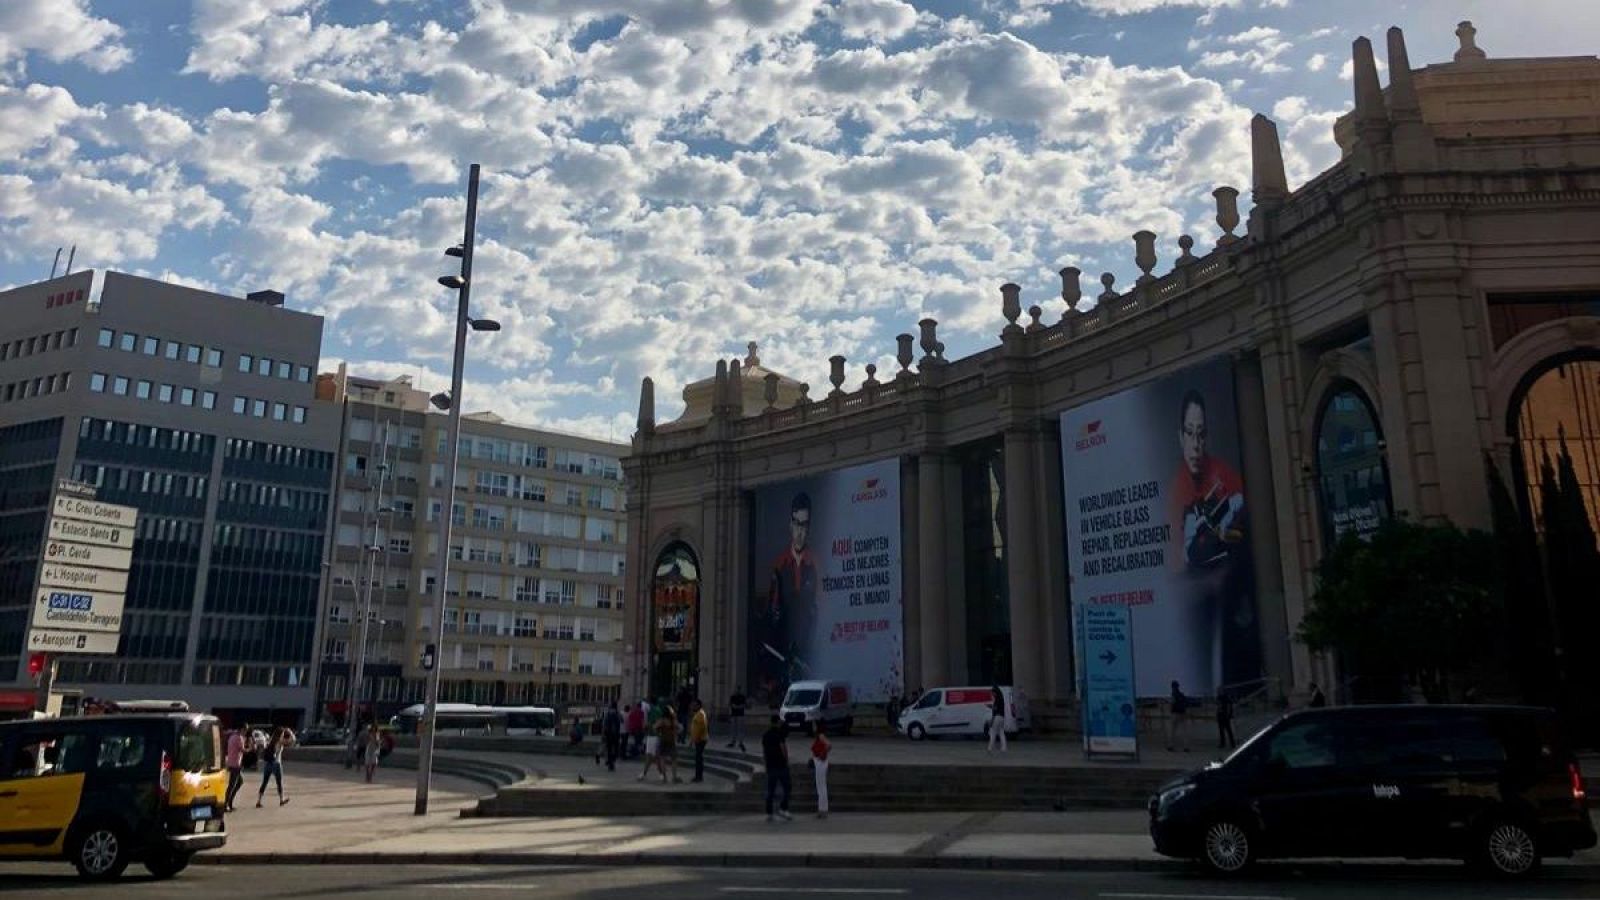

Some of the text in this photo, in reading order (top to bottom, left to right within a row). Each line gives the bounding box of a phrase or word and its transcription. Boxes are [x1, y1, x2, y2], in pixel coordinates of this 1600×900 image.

[1076, 435, 1106, 450] BELRON
[1079, 481, 1159, 512] WORLDWIDE LEADER
[76, 502, 92, 514] Creu
[94, 505, 120, 519] Coberta
[1081, 506, 1150, 534] IN VEHICLE GLASS
[90, 527, 109, 540] Sants
[1082, 524, 1170, 556] REPAIR, REPLACEMENT
[854, 536, 888, 553] COMPITEN
[842, 552, 889, 572] LOS MEJORES
[1084, 549, 1164, 576] AND RECALIBRATION
[856, 575, 865, 588] EN
[867, 571, 889, 587] LUNAS
[850, 590, 890, 606] DEL MUNDO
[42, 633, 76, 647] Aeroport
